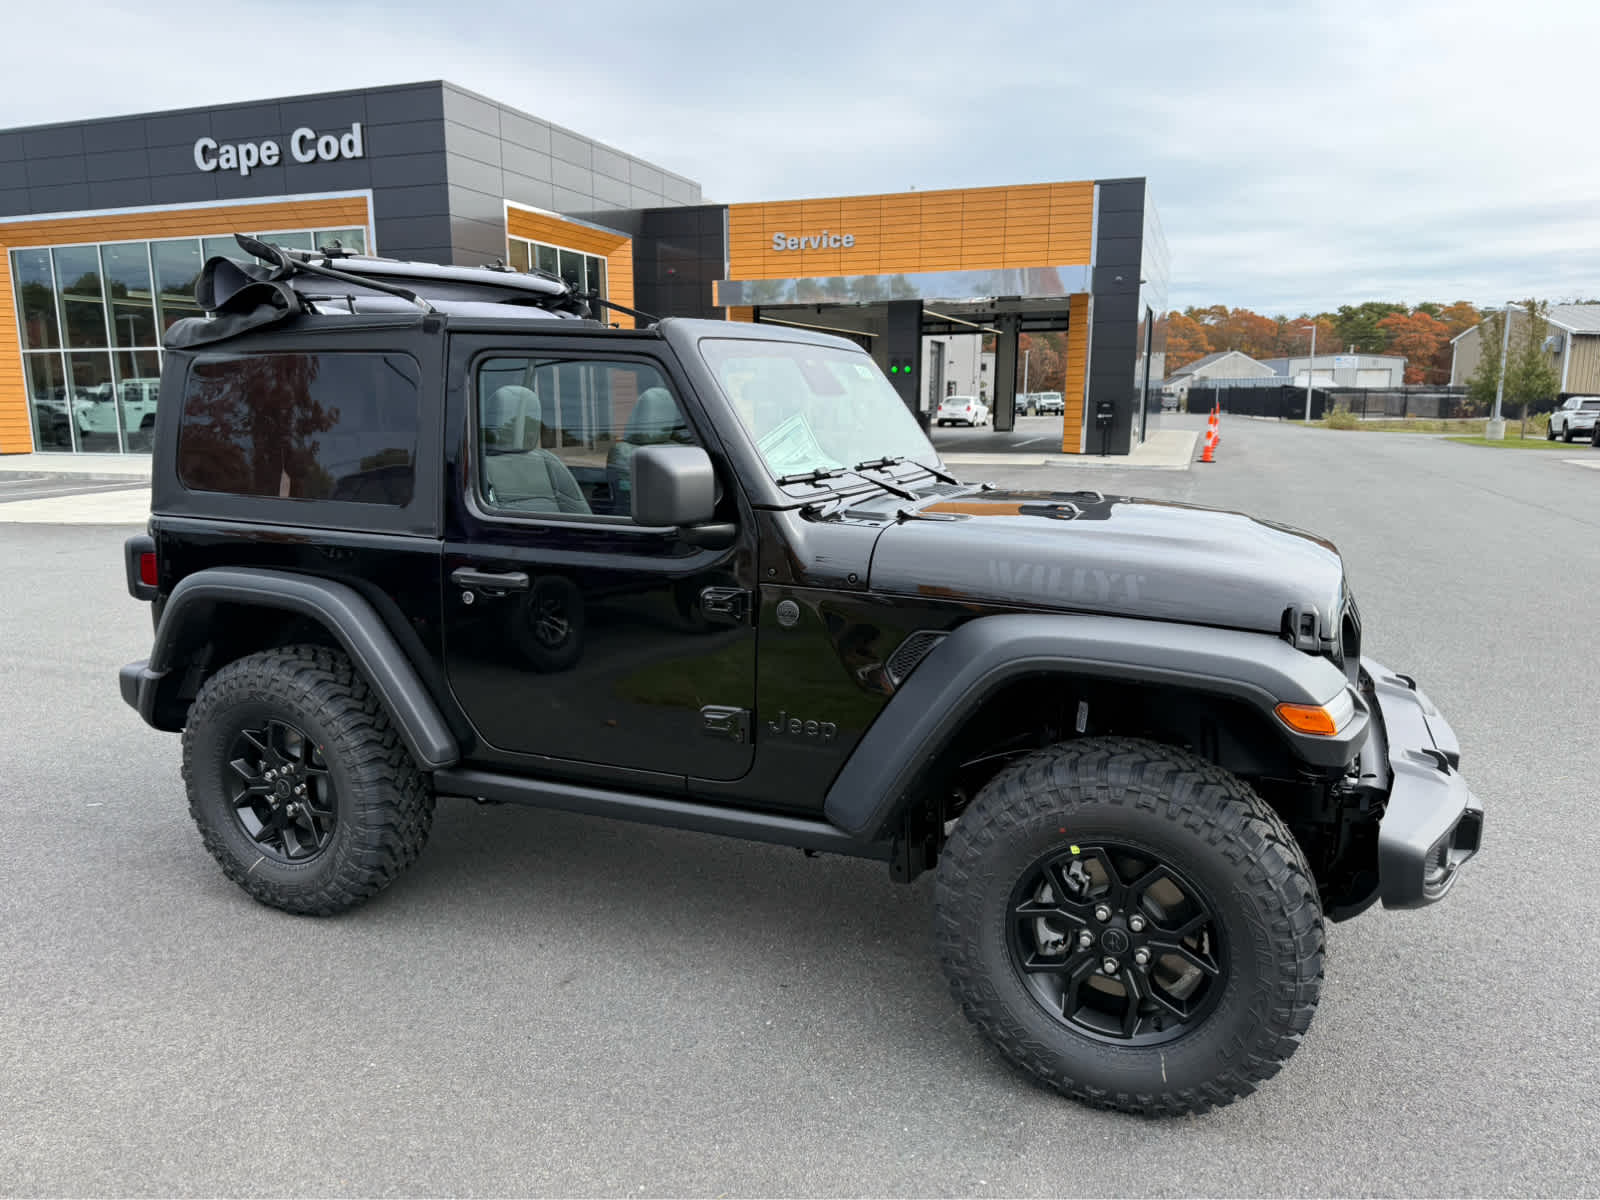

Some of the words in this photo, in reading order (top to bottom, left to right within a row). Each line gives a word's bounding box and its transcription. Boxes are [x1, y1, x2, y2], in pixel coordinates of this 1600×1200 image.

[194, 137, 280, 176] Cape
[291, 122, 364, 163] Cod
[772, 230, 855, 251] Service
[768, 711, 837, 743] Jeep
